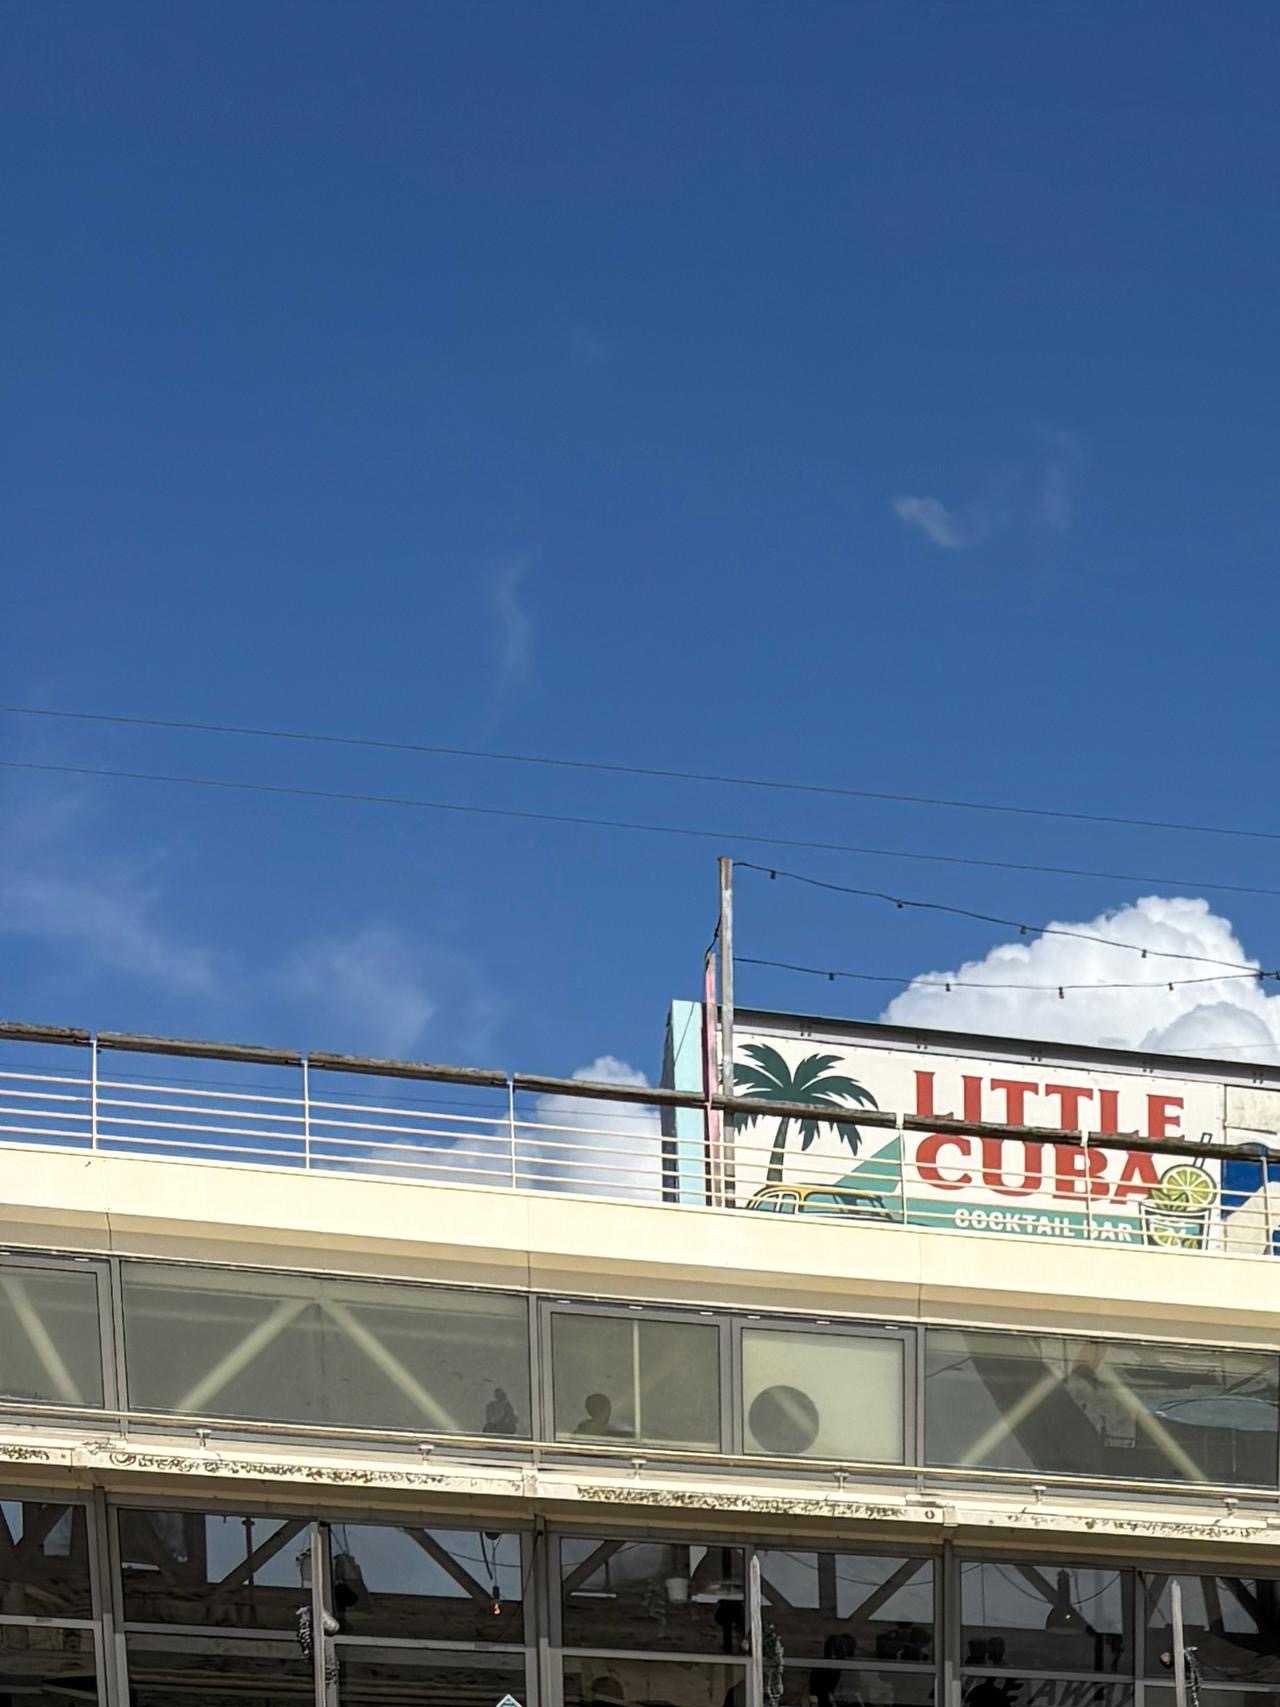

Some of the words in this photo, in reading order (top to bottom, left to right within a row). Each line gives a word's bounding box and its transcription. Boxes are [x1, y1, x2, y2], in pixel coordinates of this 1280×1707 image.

[914, 1070, 1187, 1141] LITTLE
[914, 1133, 1163, 1205] CUBA
[954, 1207, 1076, 1237] COCKTAIL
[1083, 1219, 1134, 1242] BAR
